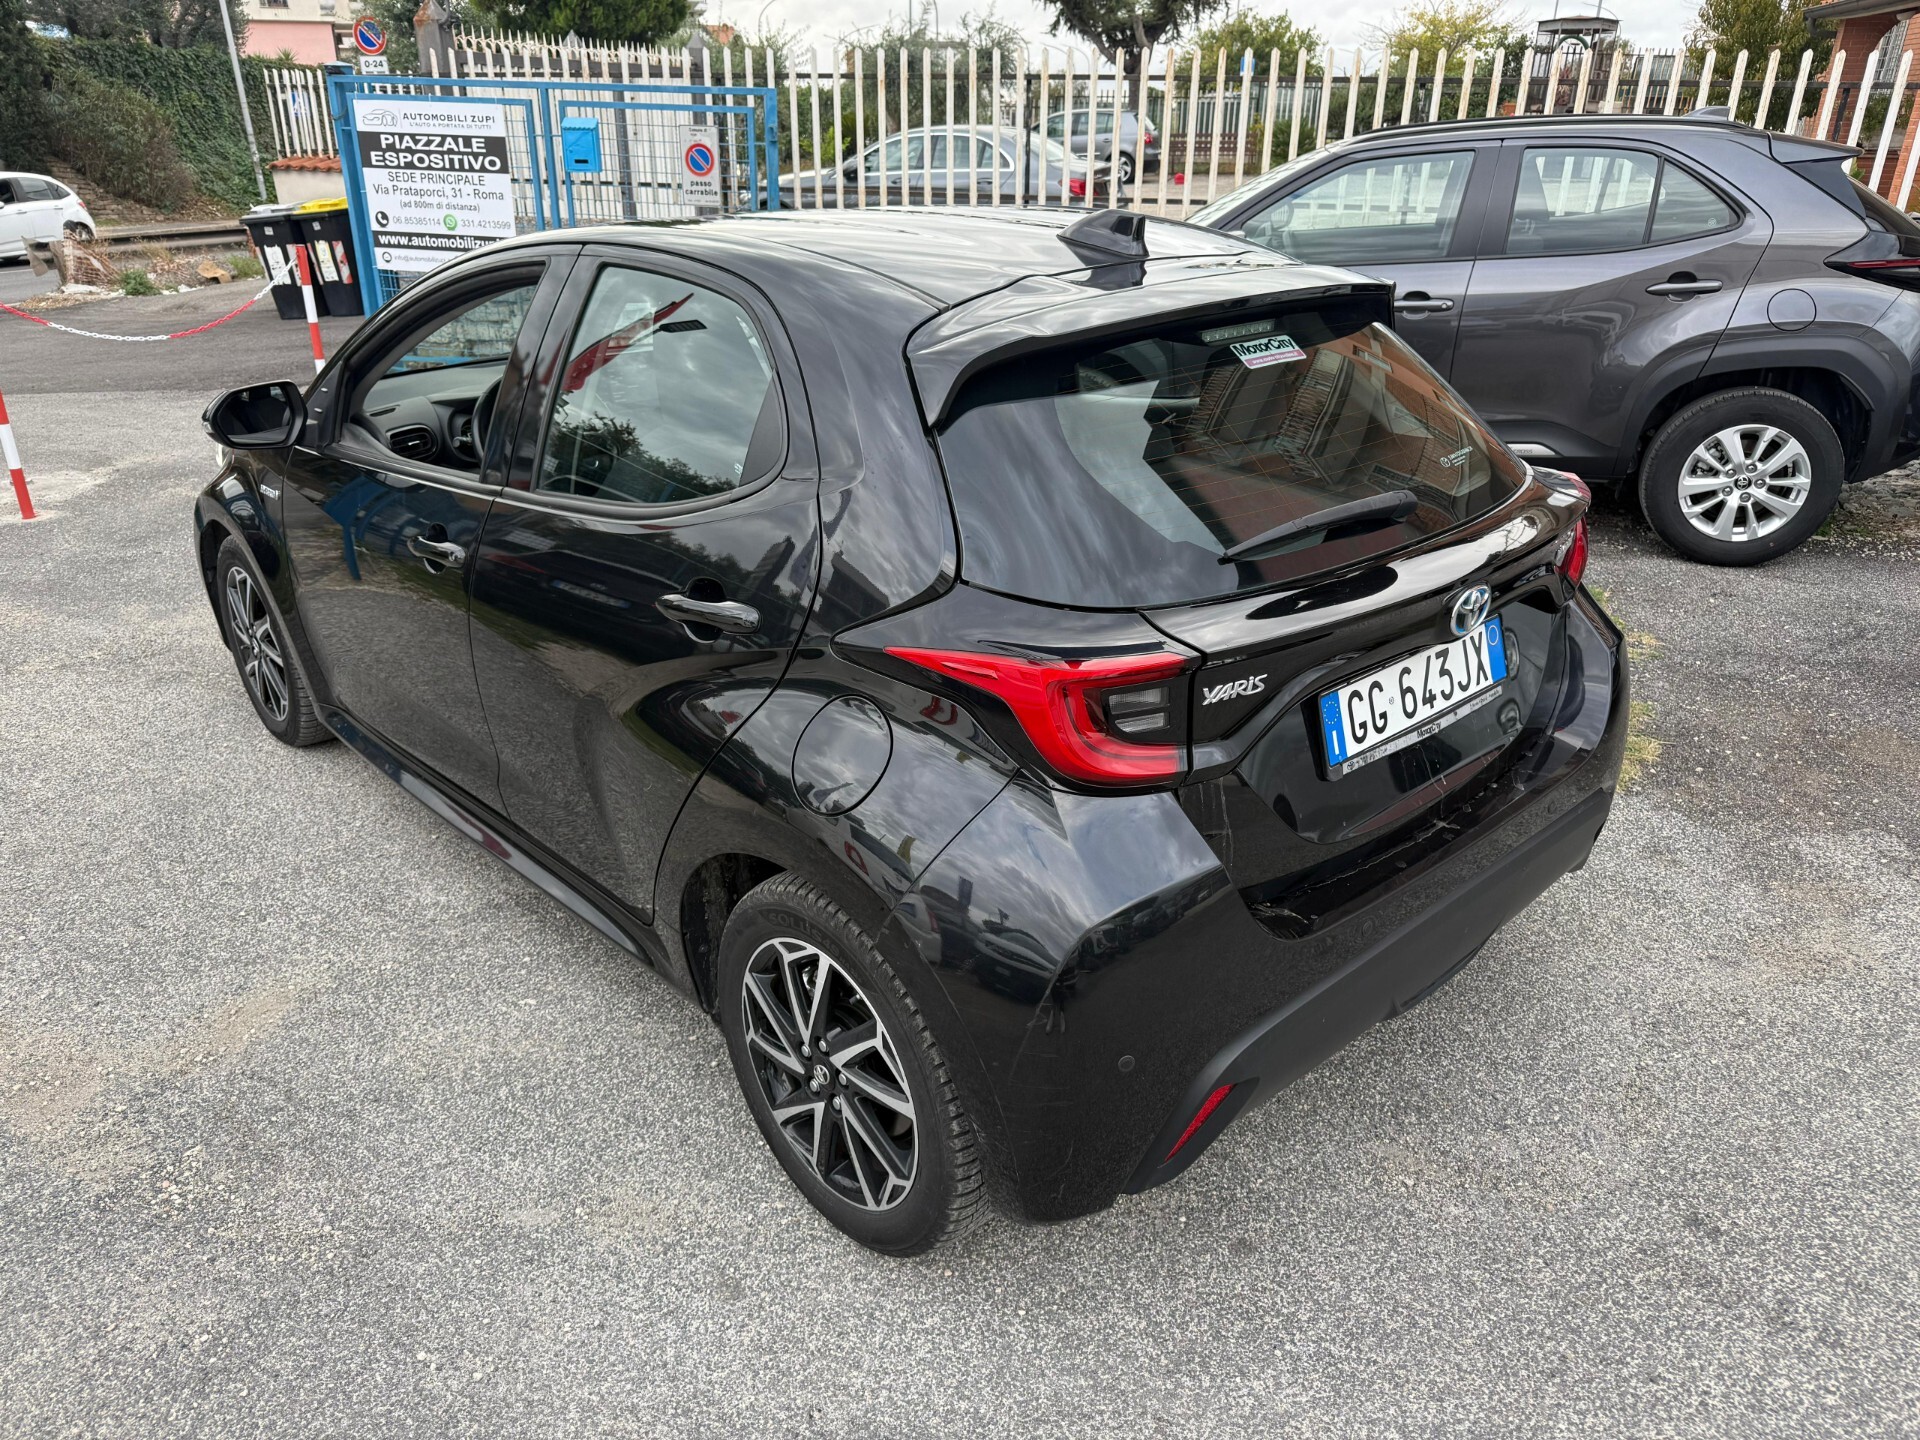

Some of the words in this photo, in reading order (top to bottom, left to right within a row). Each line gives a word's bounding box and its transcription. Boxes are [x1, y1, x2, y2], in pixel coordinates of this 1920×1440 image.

[364, 60, 384, 68] 0-24
[402, 112, 468, 123] AUTOMOBILI
[470, 115, 496, 123] ZUPI
[379, 134, 487, 153] PIAZZALE
[369, 151, 502, 171] ESPOSITIVO
[387, 171, 417, 184] SEDE
[420, 173, 486, 187] PRINCIPALE
[690, 180, 712, 188] passo
[373, 184, 390, 195] Via
[392, 185, 449, 200] Prataporci,
[451, 187, 464, 199] 31
[473, 189, 504, 201] Roma
[685, 188, 719, 197] carrabile
[399, 200, 412, 209] (ad
[413, 201, 435, 210] 800m
[436, 202, 444, 210] di
[445, 202, 481, 213] distanza)
[1202, 673, 1268, 706] YARIS
[1347, 680, 1389, 745] GG
